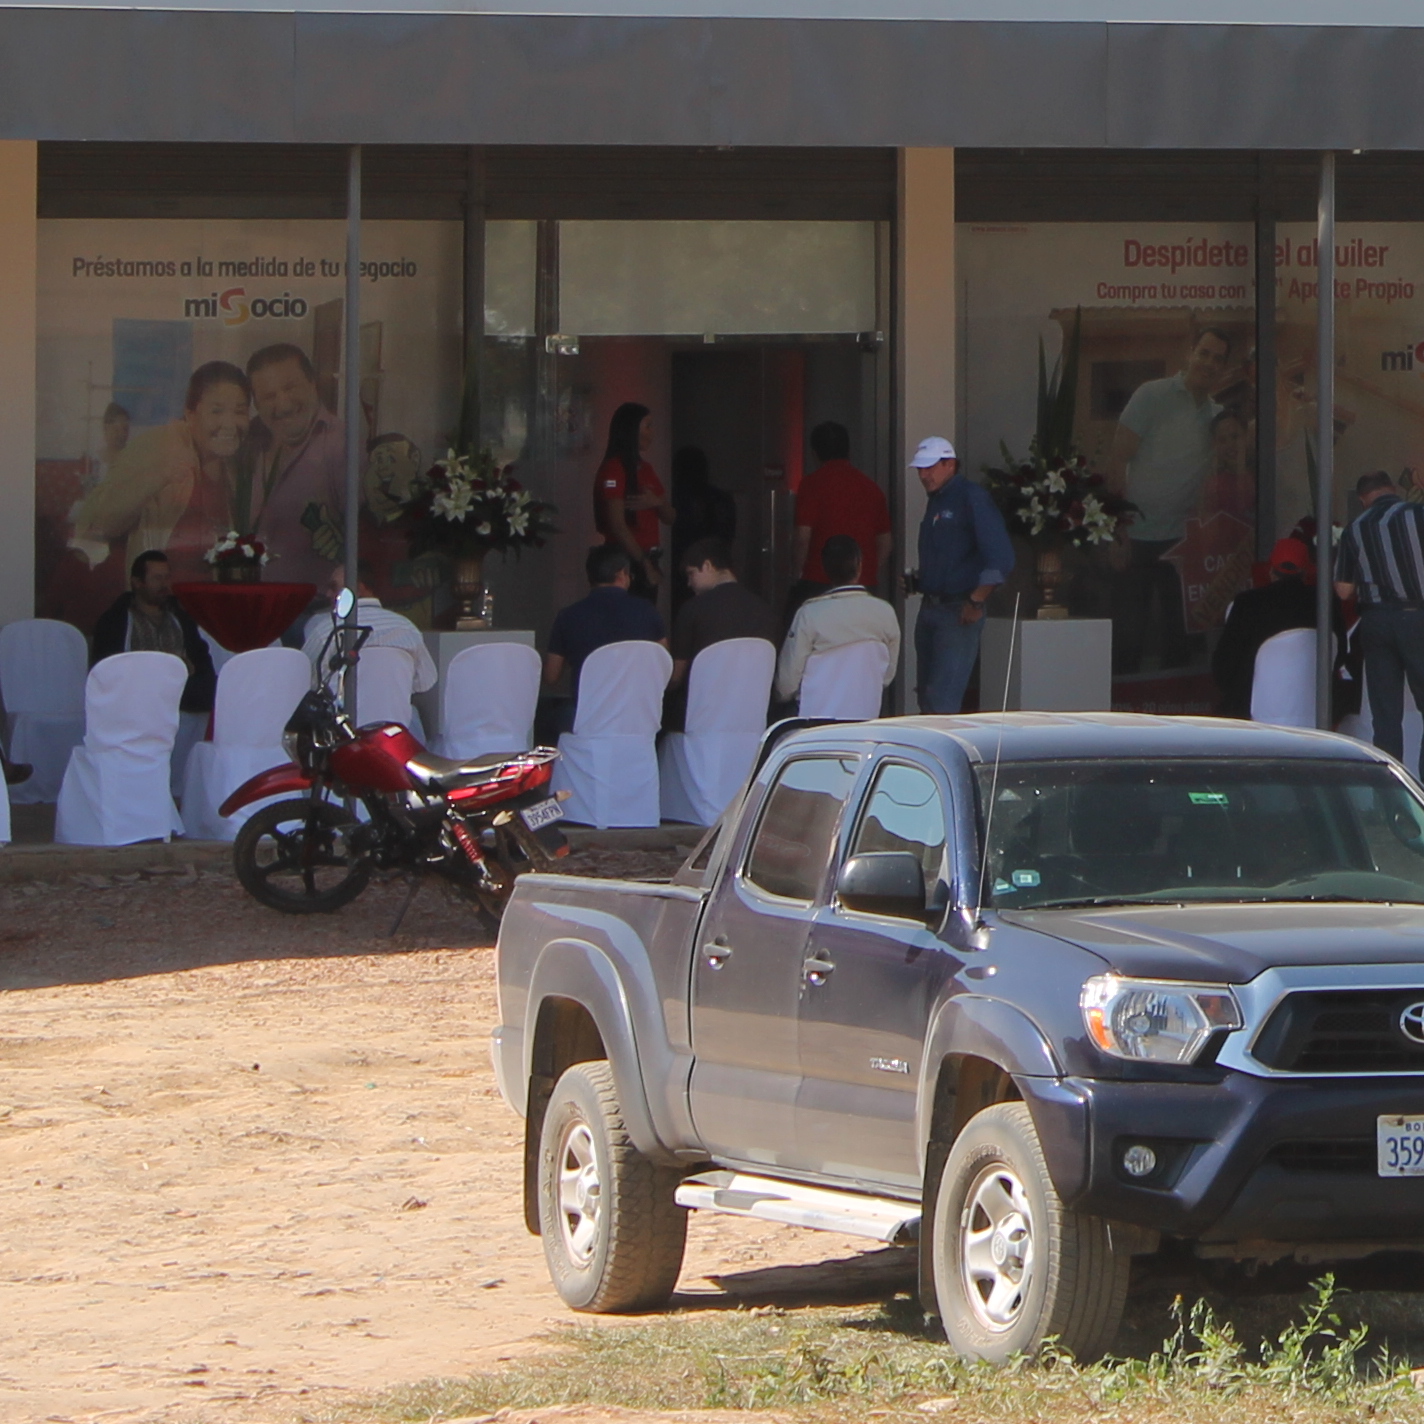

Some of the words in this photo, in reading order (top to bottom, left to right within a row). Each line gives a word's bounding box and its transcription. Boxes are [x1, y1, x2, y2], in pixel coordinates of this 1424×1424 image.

[72, 256, 176, 278] Préstamos
[180, 261, 192, 278] a
[197, 257, 213, 278] la
[218, 257, 289, 278] medida
[292, 257, 316, 278] de
[320, 259, 340, 278] tu
[345, 257, 417, 283] egocio
[1123, 237, 1249, 274] Despídete
[1296, 238, 1390, 268] aluiler
[184, 287, 307, 325] miSocio
[1096, 282, 1157, 303] Compra
[1161, 283, 1176, 300] tu
[1179, 285, 1215, 300] casa
[1218, 285, 1246, 300] con
[1287, 278, 1351, 302] Apote
[1355, 277, 1415, 303] Propio
